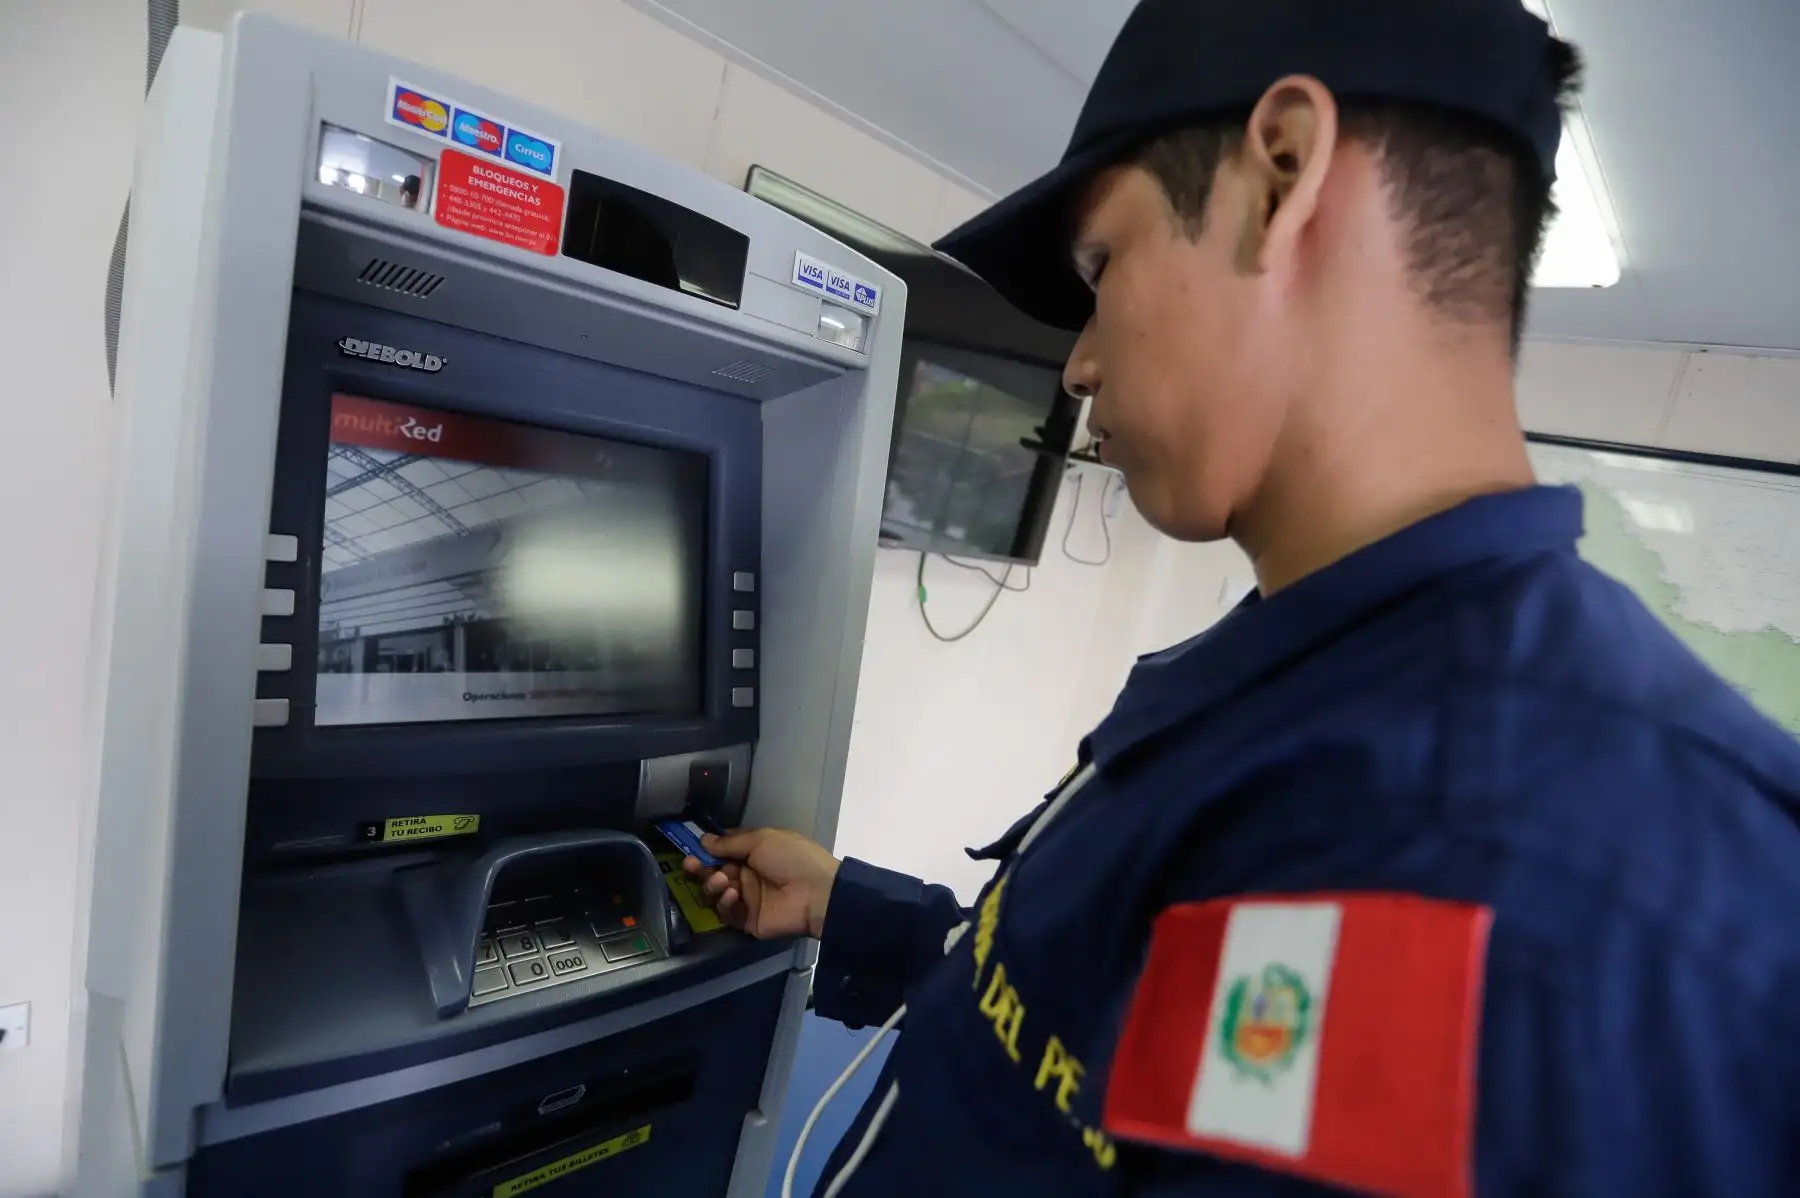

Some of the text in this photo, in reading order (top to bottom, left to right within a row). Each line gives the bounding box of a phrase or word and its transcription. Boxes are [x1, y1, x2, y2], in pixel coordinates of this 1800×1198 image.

[472, 165, 540, 193] BLOQUEOS Y
[468, 176, 541, 206] EMERGENCIAS
[803, 264, 823, 281] VISA
[831, 276, 850, 292] VISA
[860, 294, 875, 308] PLUS
[339, 337, 443, 372] DIEBOLD
[391, 818, 427, 828] RETIRA
[367, 826, 377, 837] 3
[391, 825, 443, 837] TU RECIBO
[520, 936, 532, 950] 8
[531, 962, 544, 976] 0
[556, 956, 583, 971] 000
[979, 962, 1026, 1063] DEL
[549, 1163, 568, 1177] TUS
